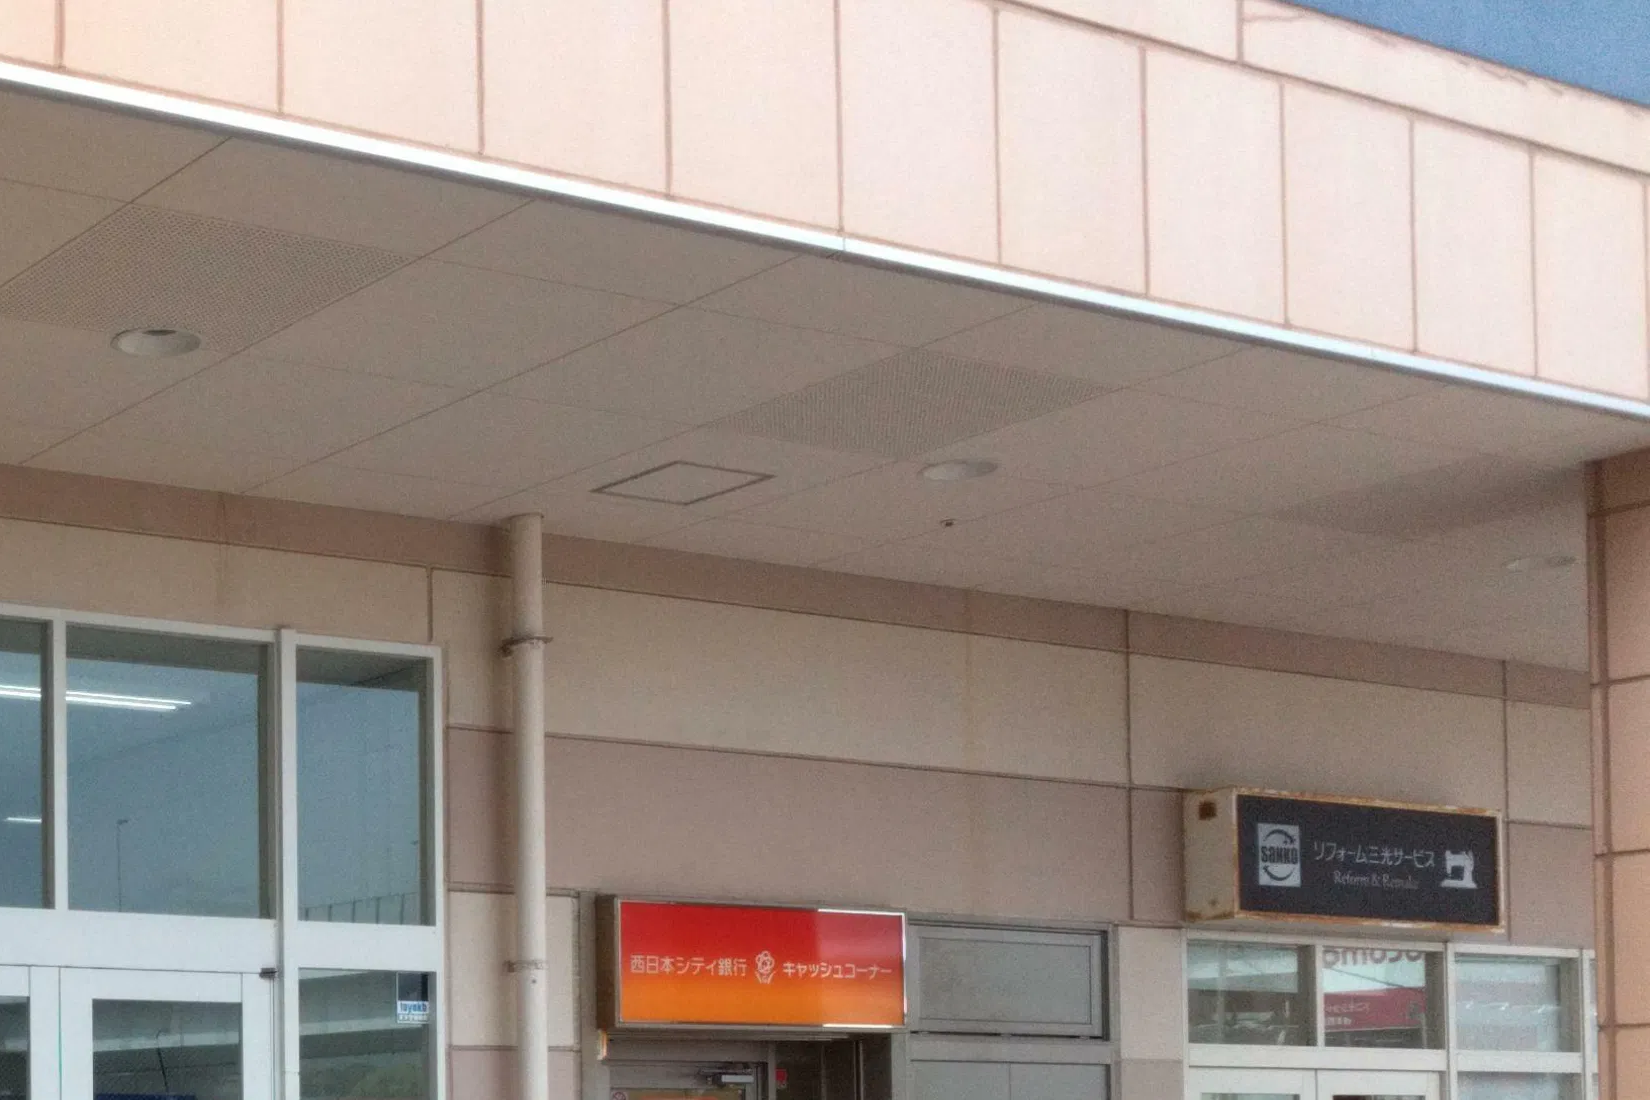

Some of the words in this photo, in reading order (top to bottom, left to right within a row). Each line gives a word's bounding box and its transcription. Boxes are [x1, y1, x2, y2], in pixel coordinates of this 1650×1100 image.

[630, 954, 747, 977] 西日本シティ銀行
[783, 961, 893, 979] キャッシュコーナー
